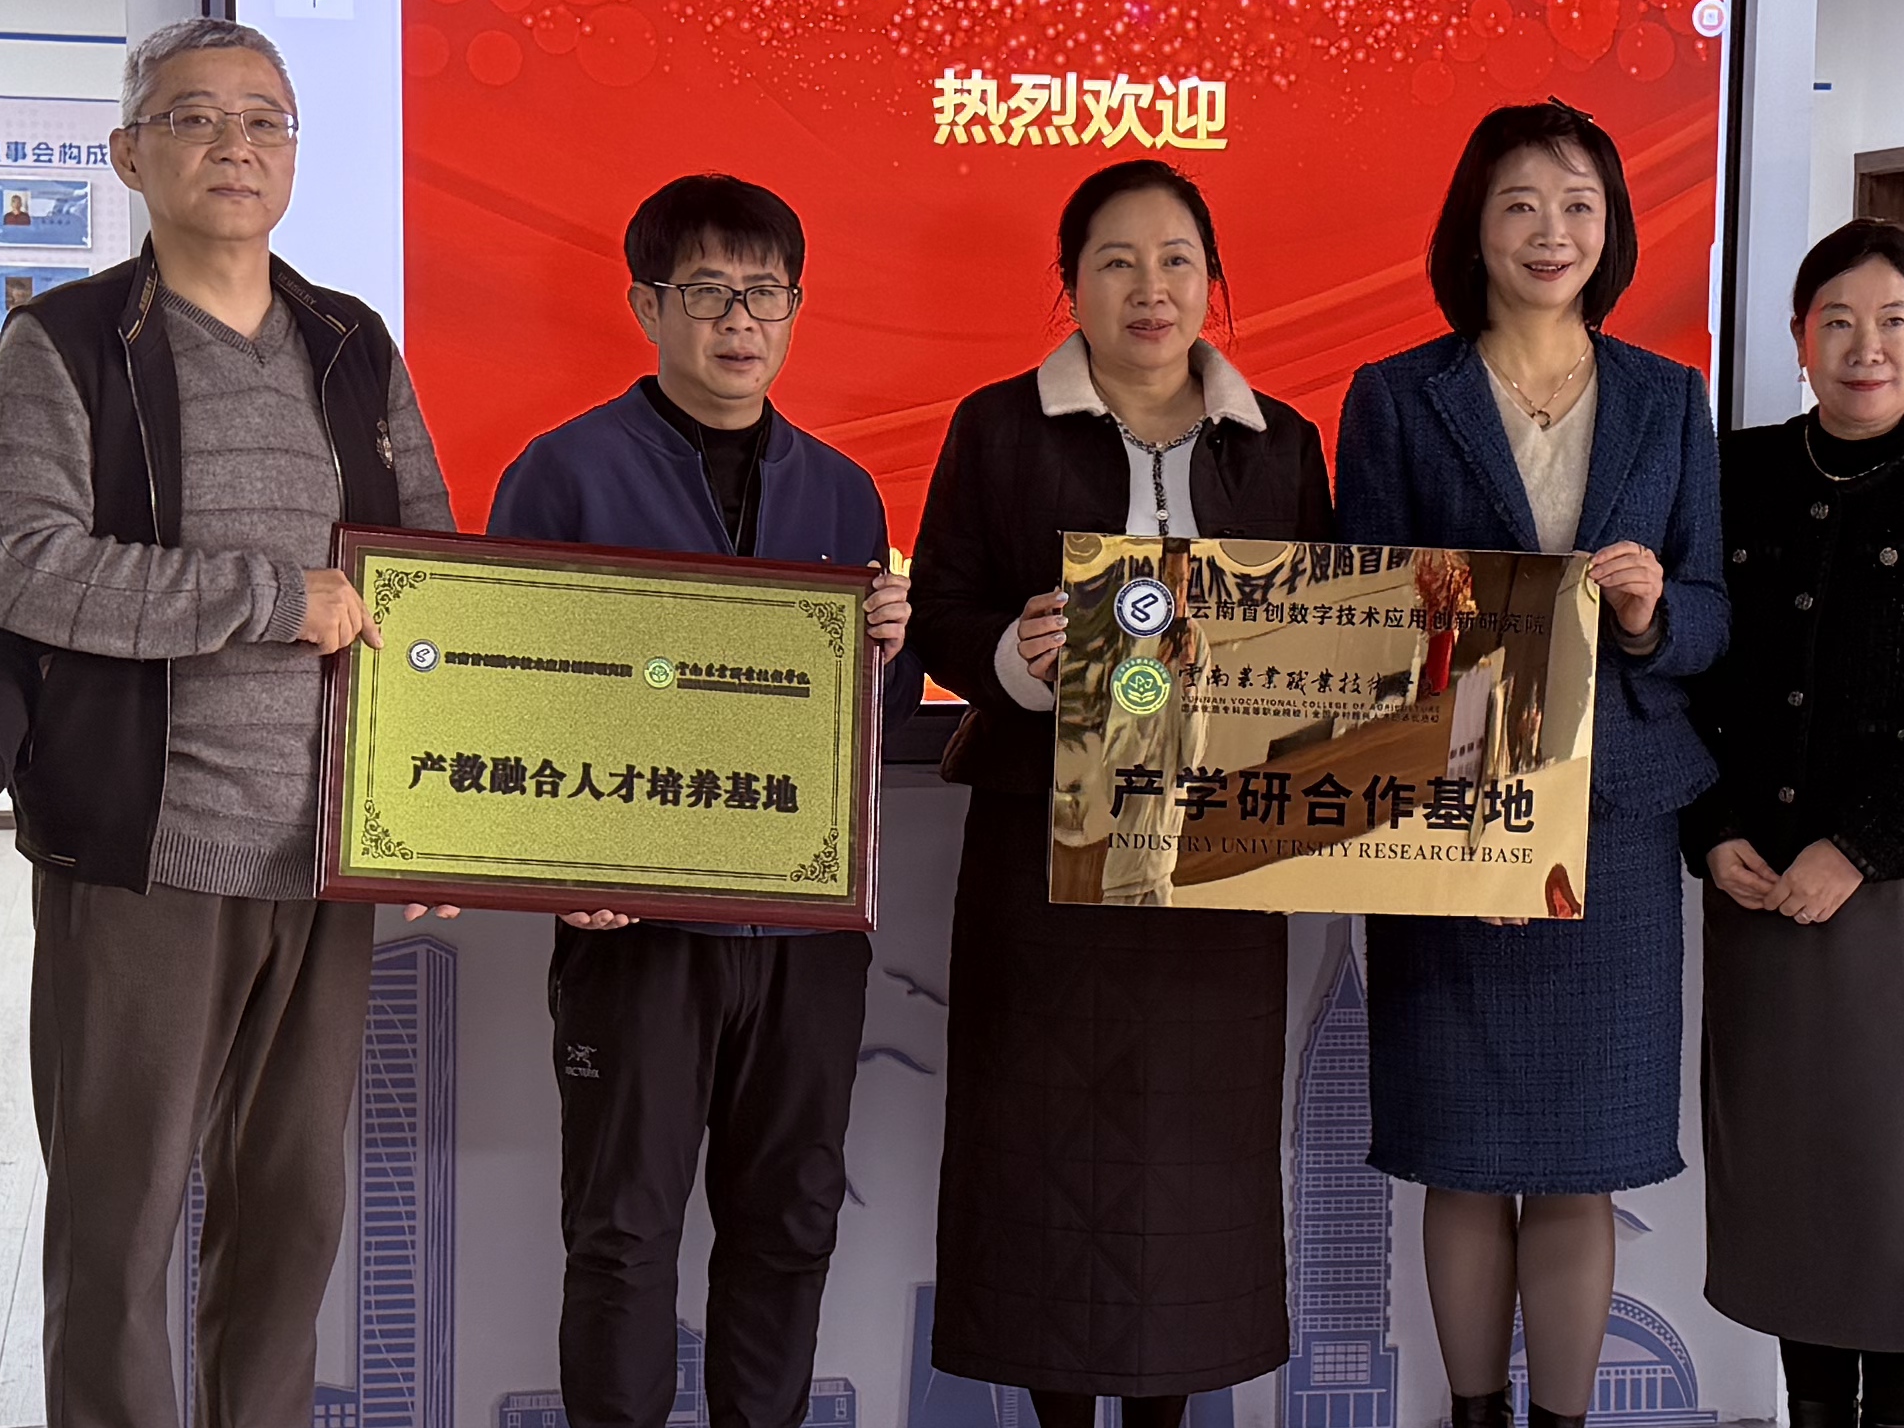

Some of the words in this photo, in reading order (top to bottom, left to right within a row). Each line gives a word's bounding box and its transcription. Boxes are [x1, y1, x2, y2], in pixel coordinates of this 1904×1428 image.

[932, 67, 1229, 151] 热烈欢迎
[1189, 599, 1546, 636] 云南首创数字技术应用创新研究院
[1180, 695, 1227, 705] YUNNAN
[1230, 697, 1298, 708] VOCATIONAL
[1301, 700, 1350, 710] COLLEGE
[1353, 702, 1367, 711] OF
[407, 750, 800, 814] 产教融合人才培养基地
[1109, 762, 1536, 835] 产学研合作基地
[1107, 831, 1213, 853] INDUSTRY
[1221, 835, 1354, 859] UNIVERSITY
[1359, 842, 1476, 862] RESEARCH
[1481, 846, 1534, 865] BASE
